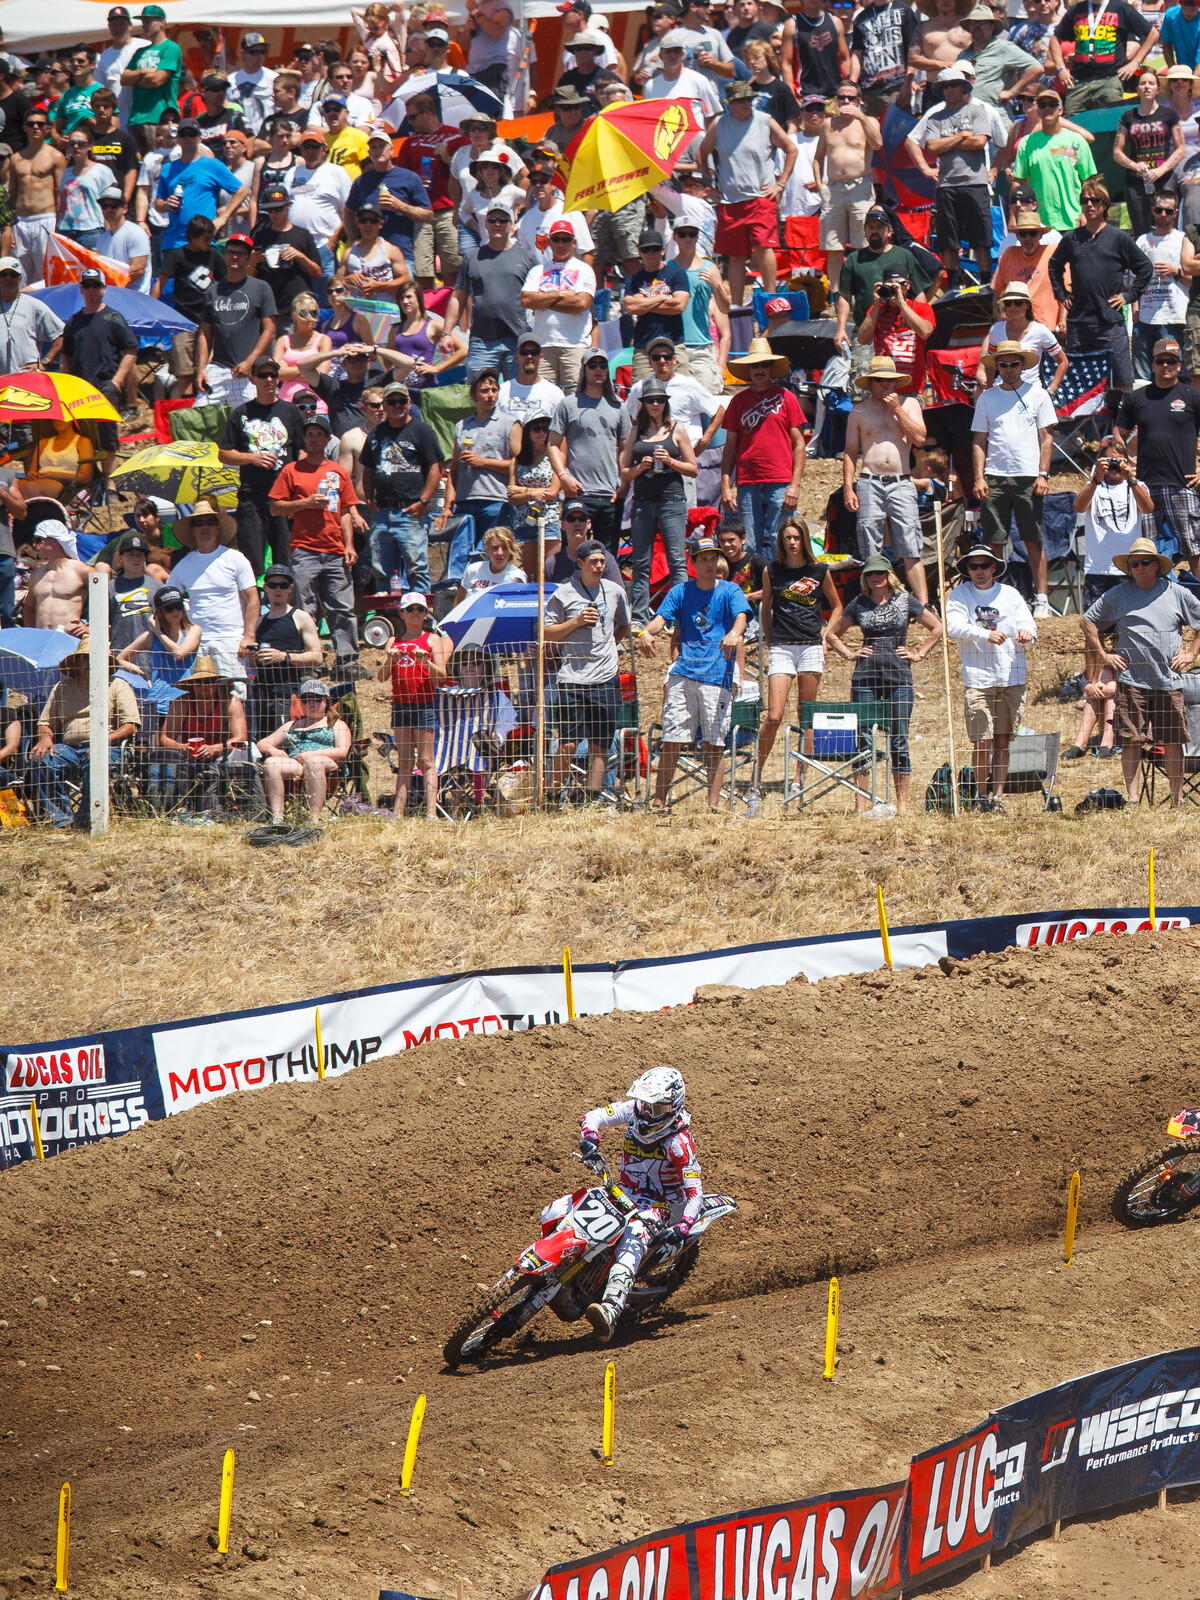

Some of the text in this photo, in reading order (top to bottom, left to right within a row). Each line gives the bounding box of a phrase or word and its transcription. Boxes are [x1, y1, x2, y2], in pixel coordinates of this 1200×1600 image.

[1130, 121, 1167, 134] FOX
[607, 166, 649, 187] POWER
[68, 398, 86, 411] FEEL
[10, 1048, 104, 1088] LUCAS OIL
[168, 1036, 383, 1102] MOTOTHUMP
[39, 1088, 85, 1105] PRO
[573, 1199, 621, 1240] 20
[1085, 1444, 1148, 1472] Performance
[921, 1432, 997, 1559] LUC
[713, 1506, 847, 1600] LUCAS
